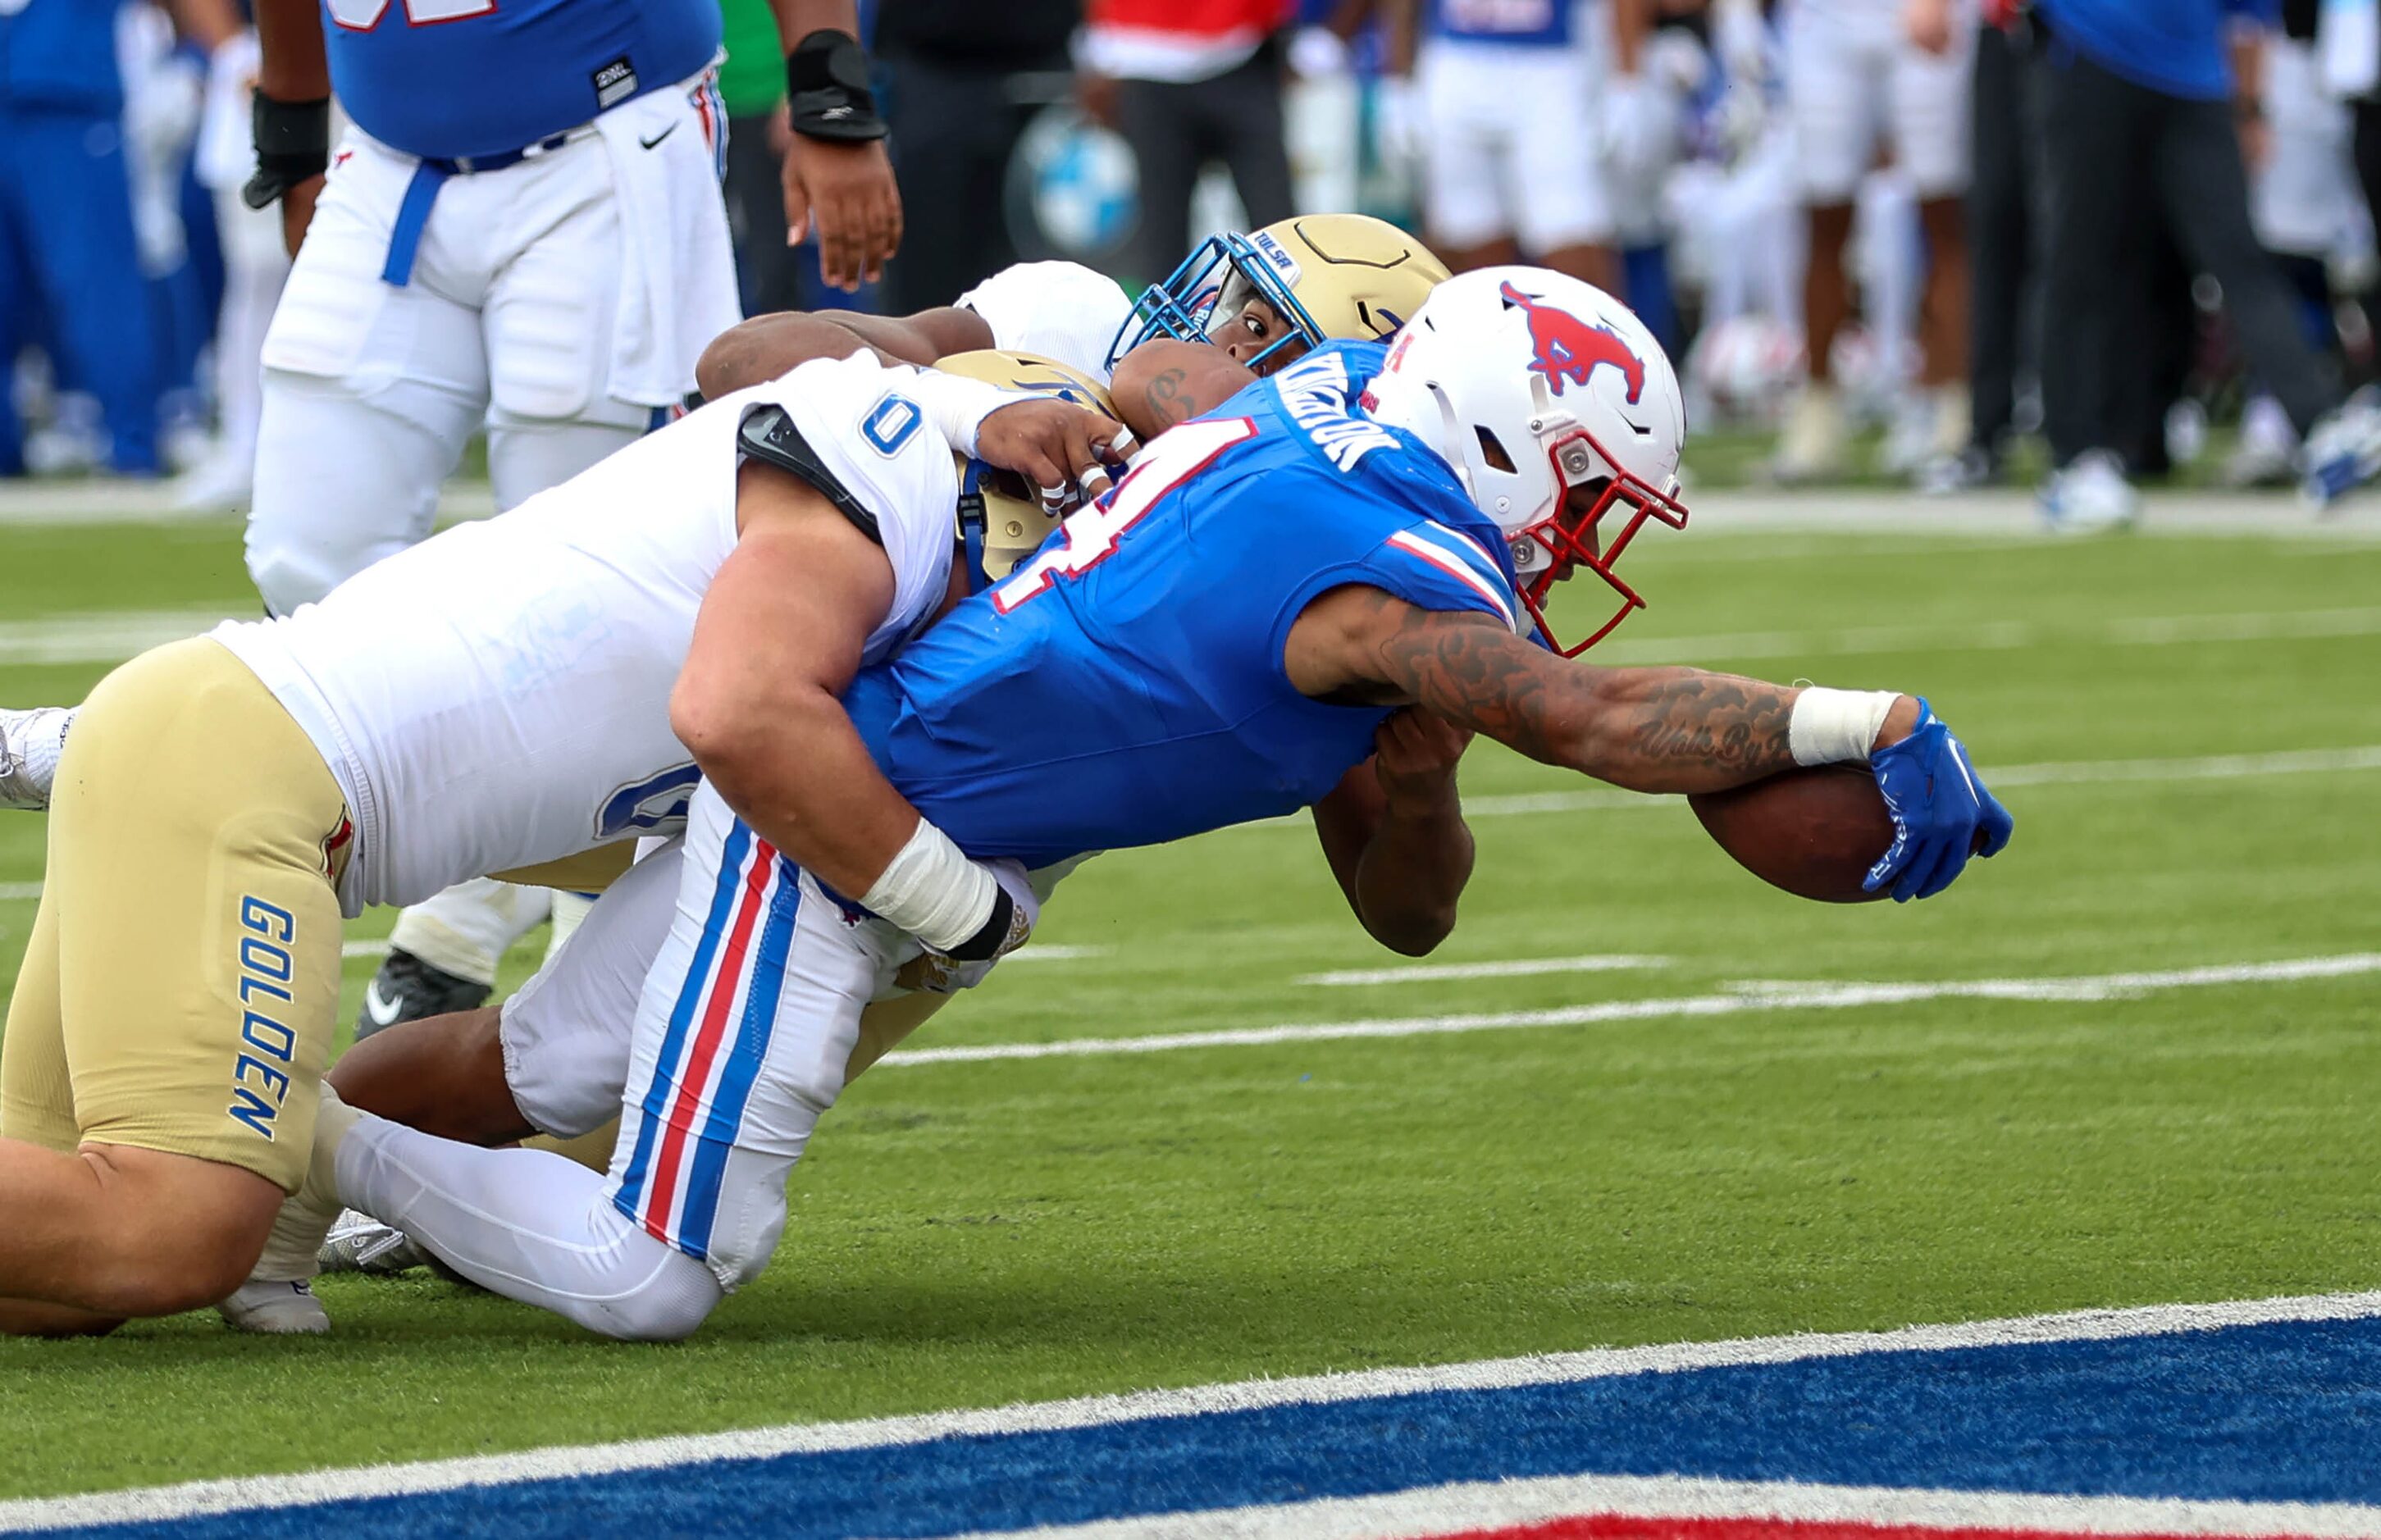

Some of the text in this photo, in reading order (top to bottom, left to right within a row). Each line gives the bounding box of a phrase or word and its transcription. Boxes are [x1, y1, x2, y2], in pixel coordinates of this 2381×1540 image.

[1254, 231, 1293, 269] TULSA
[857, 389, 924, 460] 0
[226, 893, 297, 1143] GOLDEN
